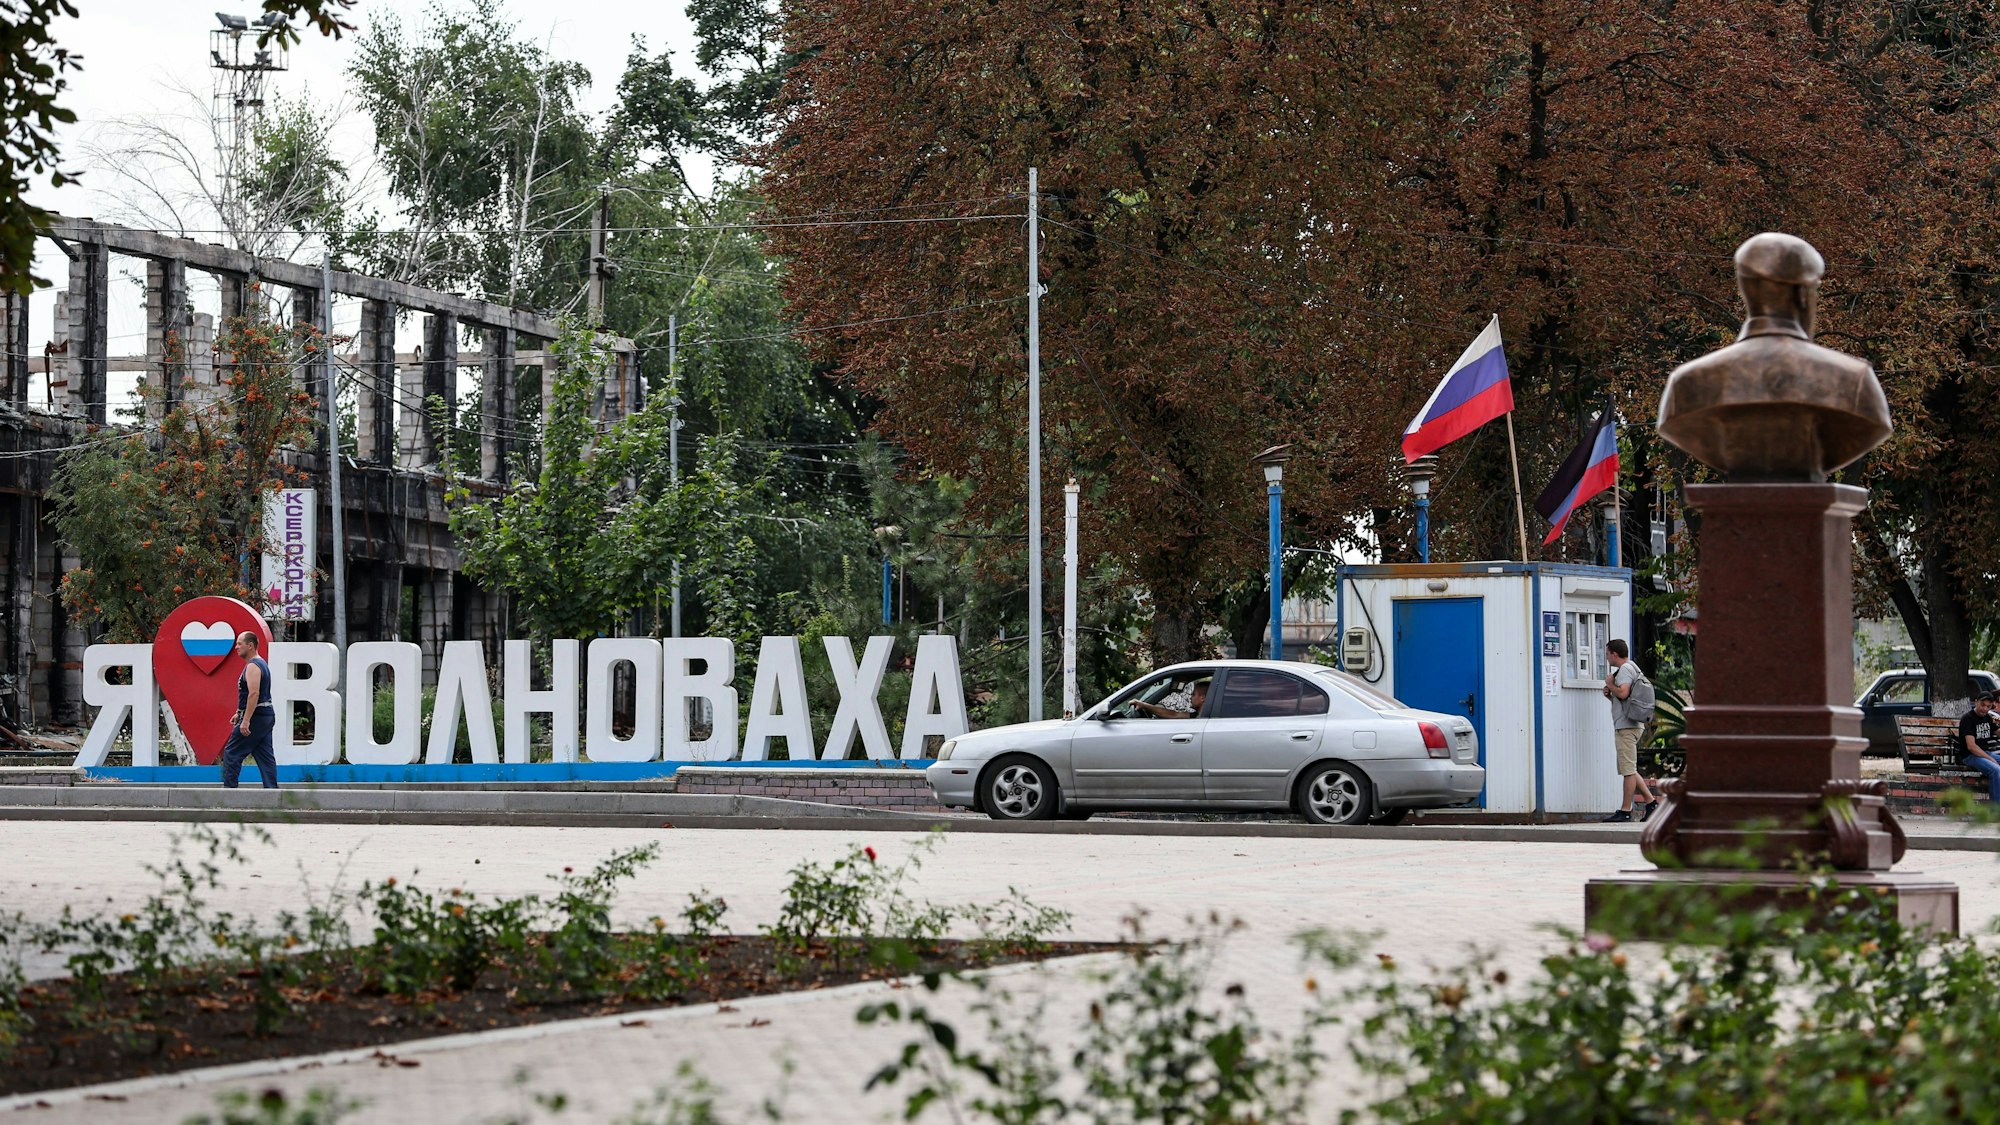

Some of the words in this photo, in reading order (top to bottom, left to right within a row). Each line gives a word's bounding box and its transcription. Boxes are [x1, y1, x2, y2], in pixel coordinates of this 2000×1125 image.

[285, 493, 303, 617] КСЕРОКОПИЯ
[73, 643, 159, 766] Я
[268, 635, 970, 765] ВОЛНОВАХА
